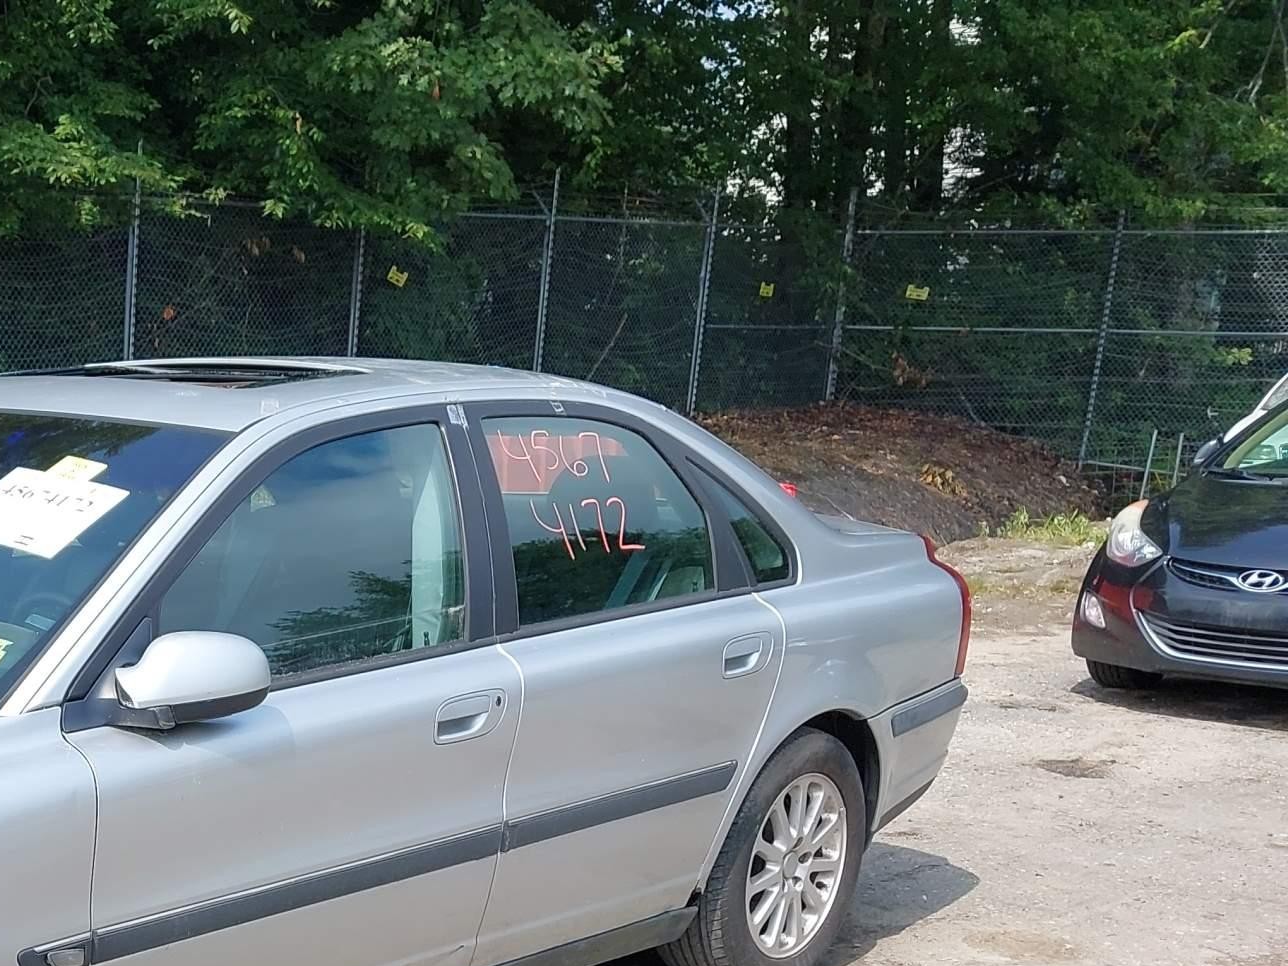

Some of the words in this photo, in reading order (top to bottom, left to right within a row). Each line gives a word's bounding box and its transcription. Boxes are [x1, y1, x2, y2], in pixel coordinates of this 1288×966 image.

[497, 429, 610, 484] 4567
[1, 484, 94, 513] 456412
[528, 496, 646, 561] 4172
